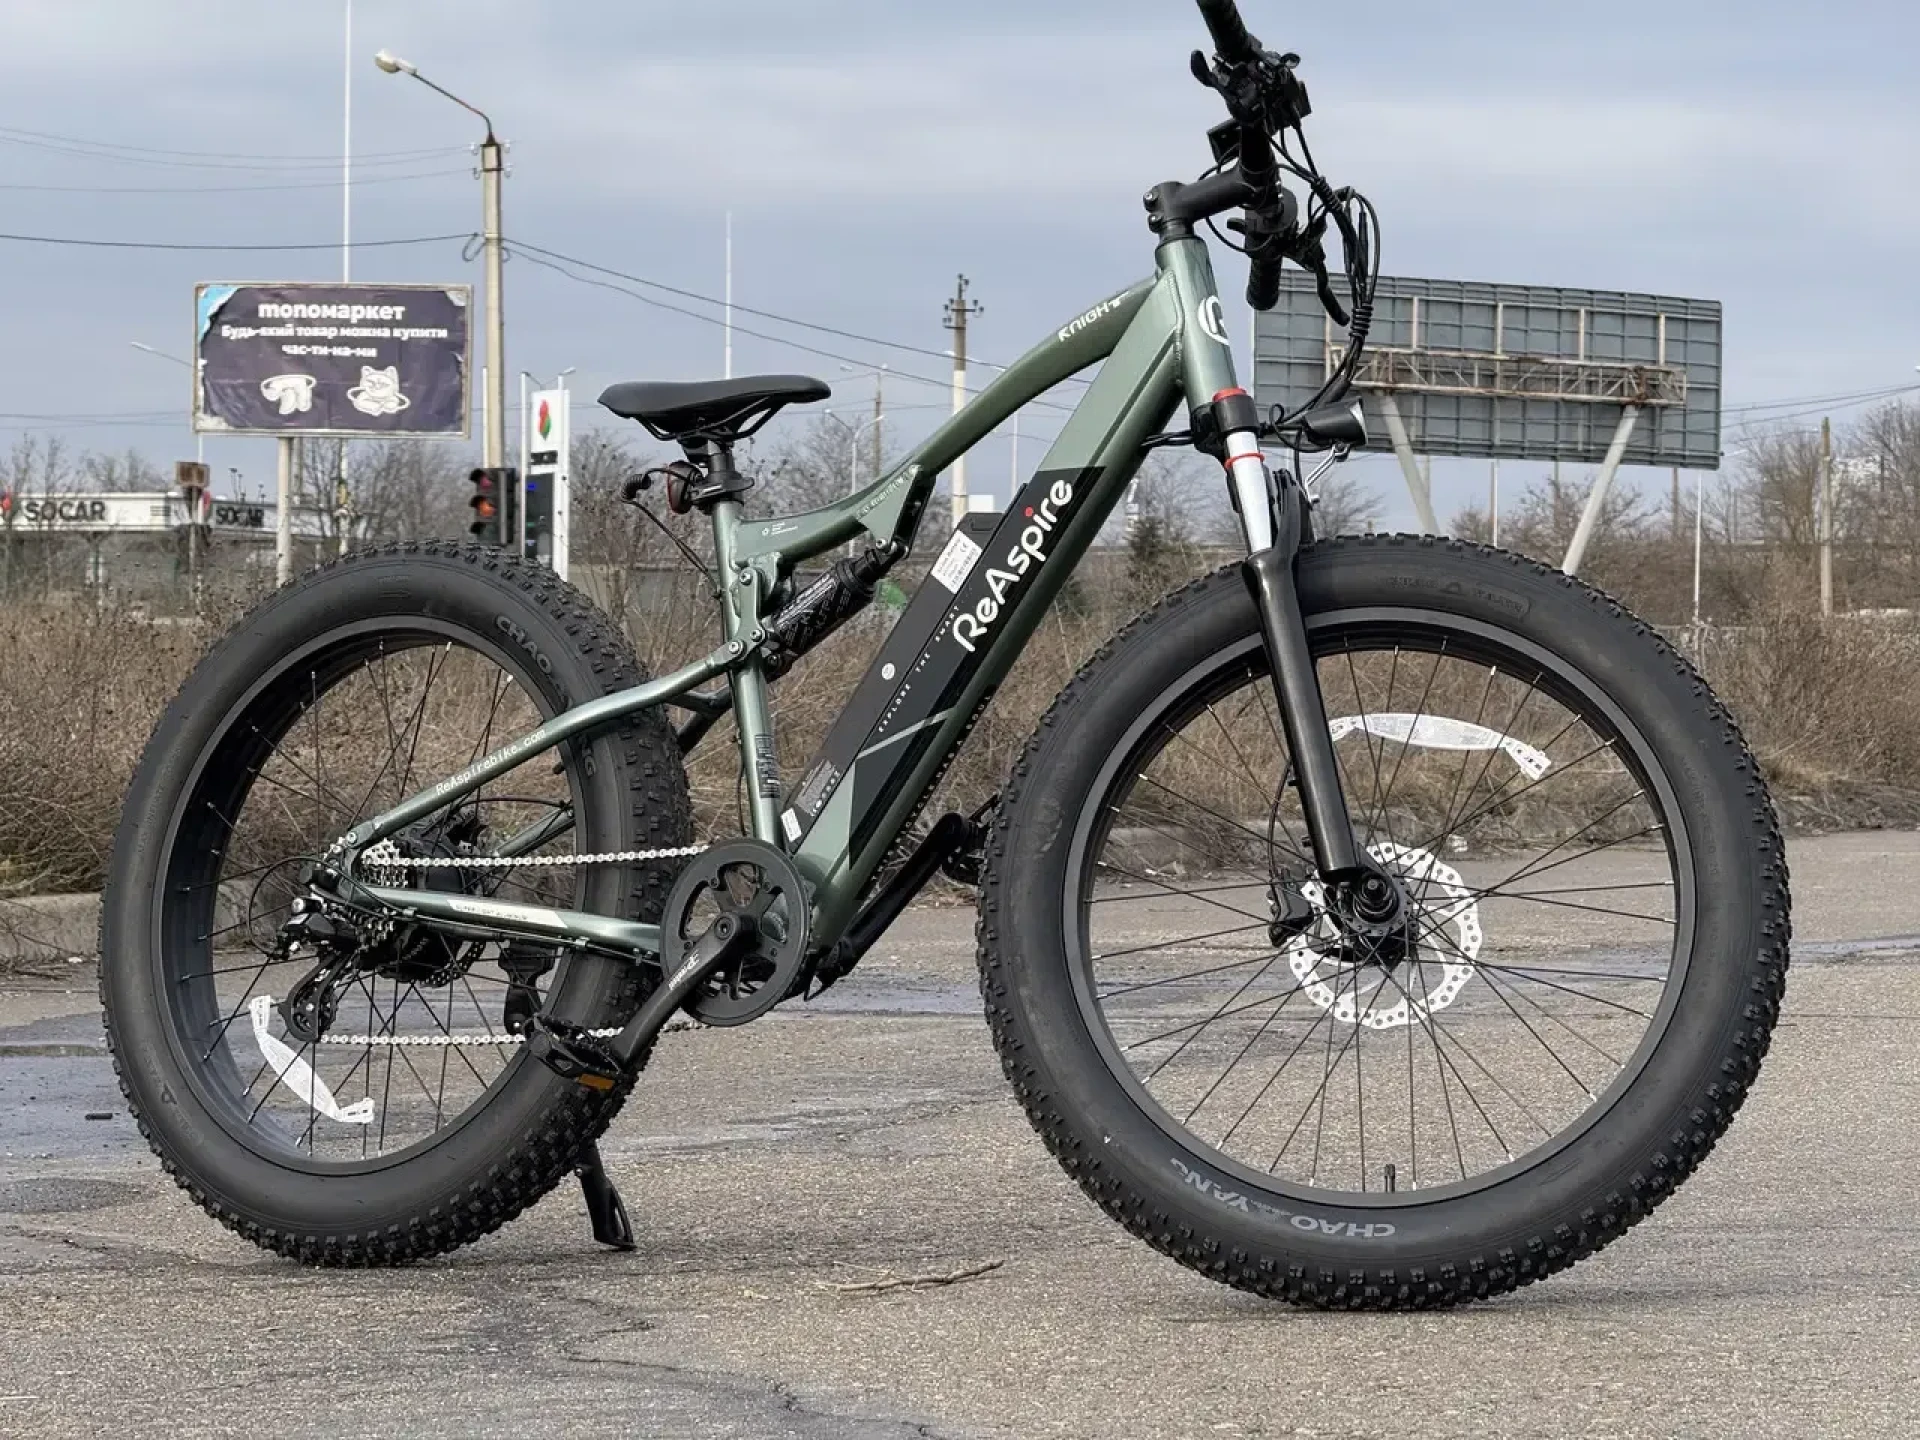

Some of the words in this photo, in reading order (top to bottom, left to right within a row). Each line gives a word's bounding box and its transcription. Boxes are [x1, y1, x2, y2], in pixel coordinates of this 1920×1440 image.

[296, 326, 338, 340] товар
[340, 327, 391, 337] можна
[392, 328, 448, 341] купити
[24, 501, 107, 522] SOCAR
[953, 479, 1073, 652] ReAspire
[495, 615, 552, 675] CHAO
[1290, 1215, 1396, 1238] CHAO
